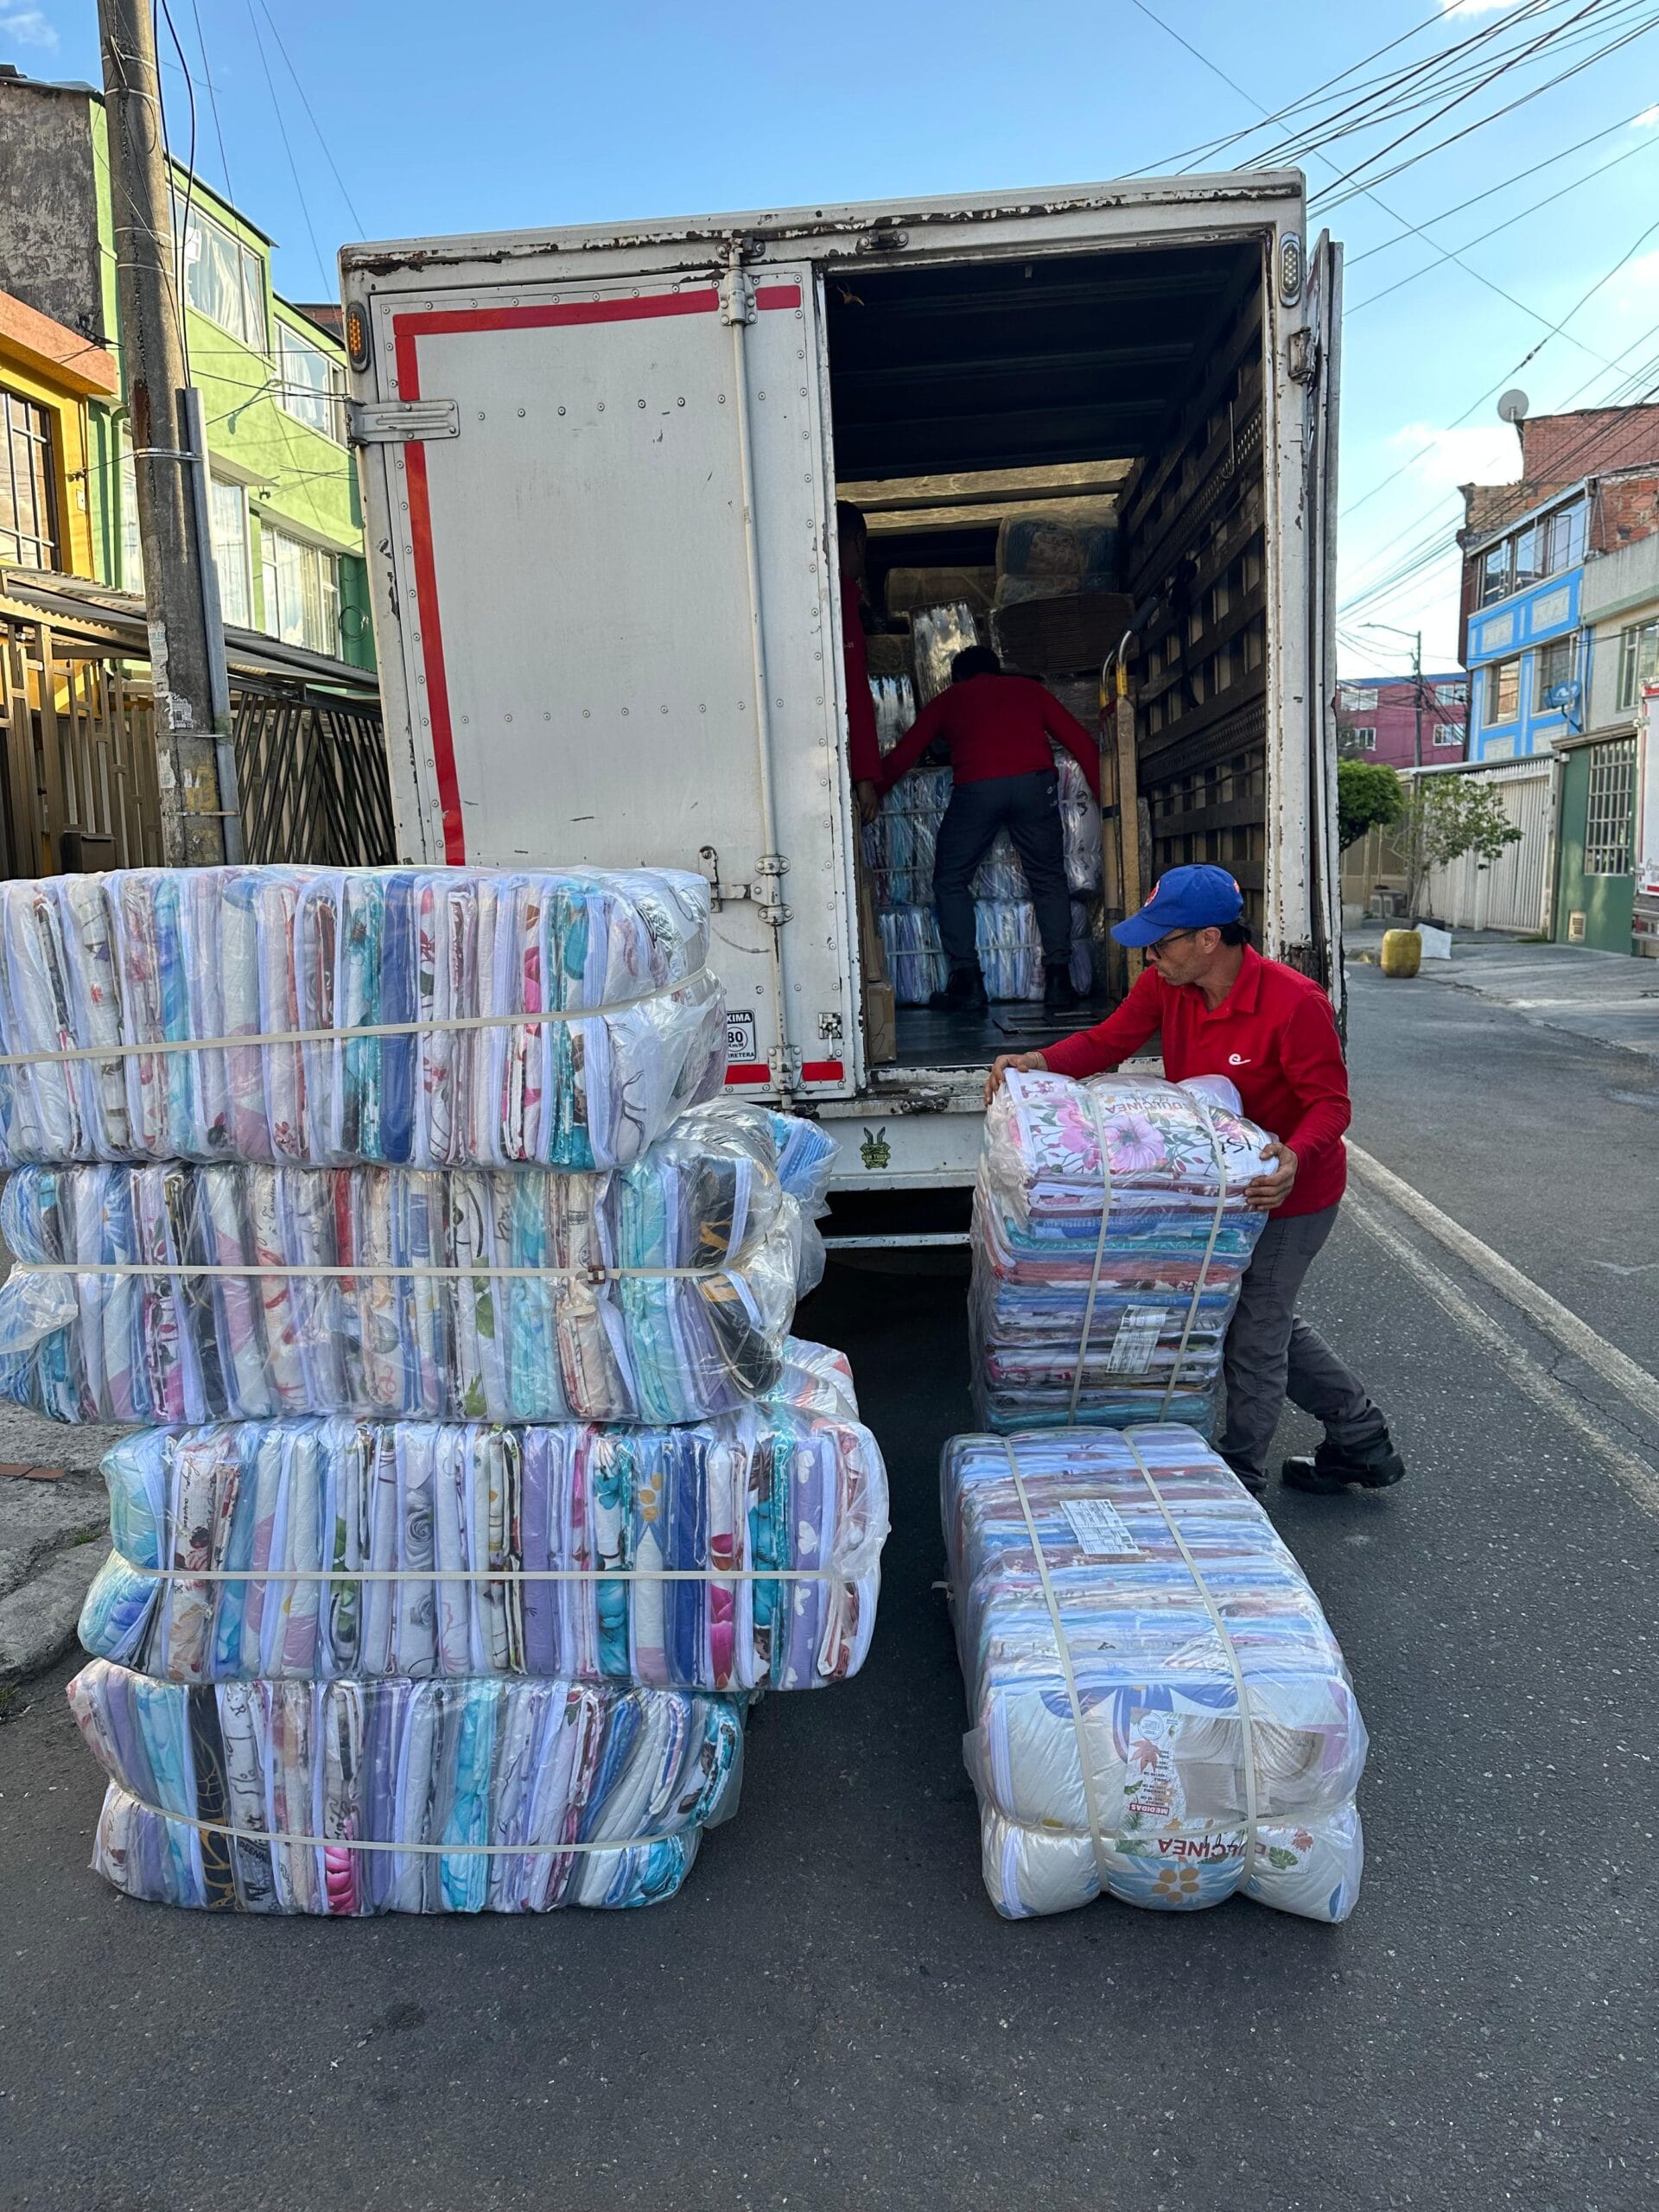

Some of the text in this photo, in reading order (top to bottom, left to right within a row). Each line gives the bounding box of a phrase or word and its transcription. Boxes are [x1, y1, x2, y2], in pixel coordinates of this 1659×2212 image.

[727, 1014, 751, 1023] XIMA
[728, 1031, 743, 1043] 80
[1105, 1102, 1184, 1114] DULCINEA
[1131, 1804, 1168, 1815] MEDIDAS
